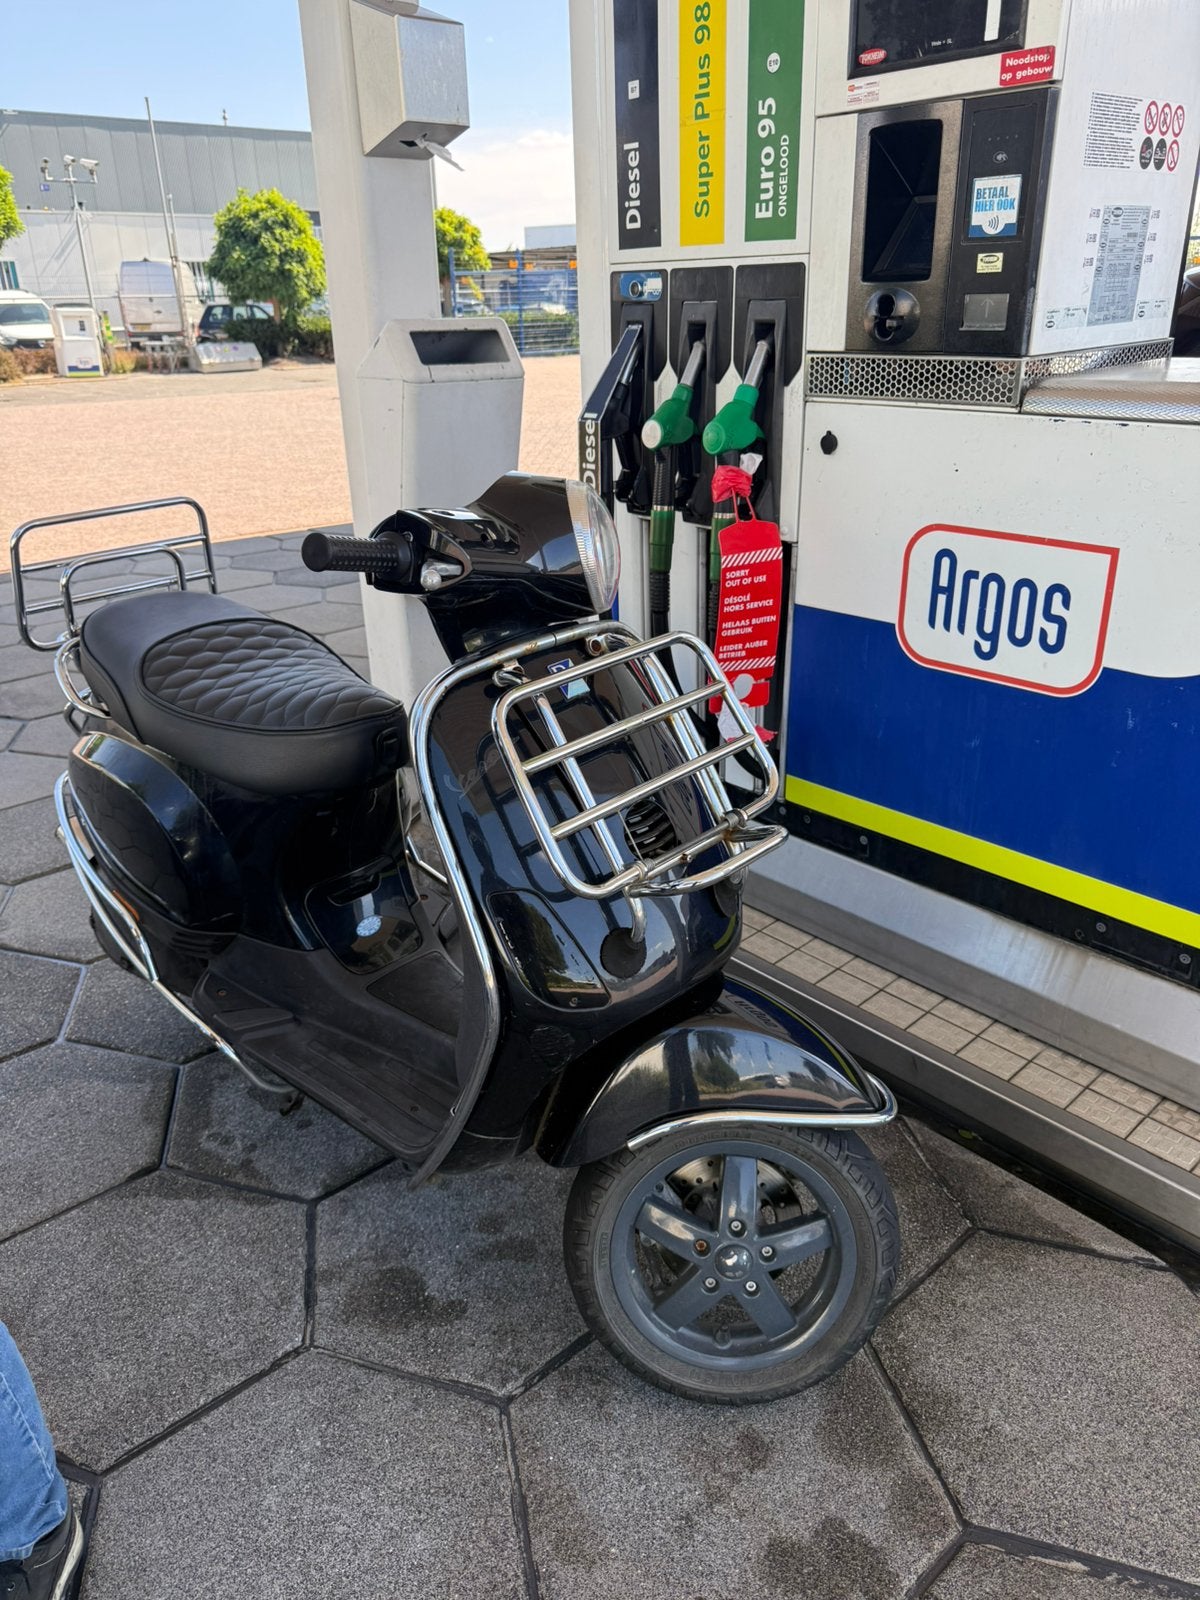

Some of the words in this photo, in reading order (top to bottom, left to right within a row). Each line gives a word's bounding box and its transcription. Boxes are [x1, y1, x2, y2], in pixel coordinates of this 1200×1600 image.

[694, 1, 711, 44] 98
[768, 58, 779, 67] E10
[1006, 54, 1050, 67] Noodstop
[1001, 72, 1013, 81] op
[1016, 65, 1053, 79] gebouw
[694, 53, 711, 120] Plus
[758, 97, 777, 139] 95
[694, 131, 714, 218] Super
[778, 134, 789, 217] ONGELOOD
[623, 141, 642, 230] Diesel
[755, 146, 775, 219] Euro
[976, 186, 1009, 200] BETAAL
[974, 200, 994, 212] HIER
[996, 198, 1015, 211] OOK
[725, 569, 749, 579] SORRY
[725, 578, 741, 588] OUT
[742, 576, 752, 585] OF
[753, 575, 767, 583] USE
[724, 593, 750, 604] DÉSOLÉ
[928, 548, 1072, 661] Argos
[723, 603, 745, 613] HORS
[746, 599, 773, 609] SERVICE
[722, 619, 750, 629] HELAAS
[751, 616, 776, 625] BUITEN
[721, 626, 753, 637] GEBRUIK
[719, 643, 743, 652] LEIDER
[718, 650, 746, 660] BETRIEB
